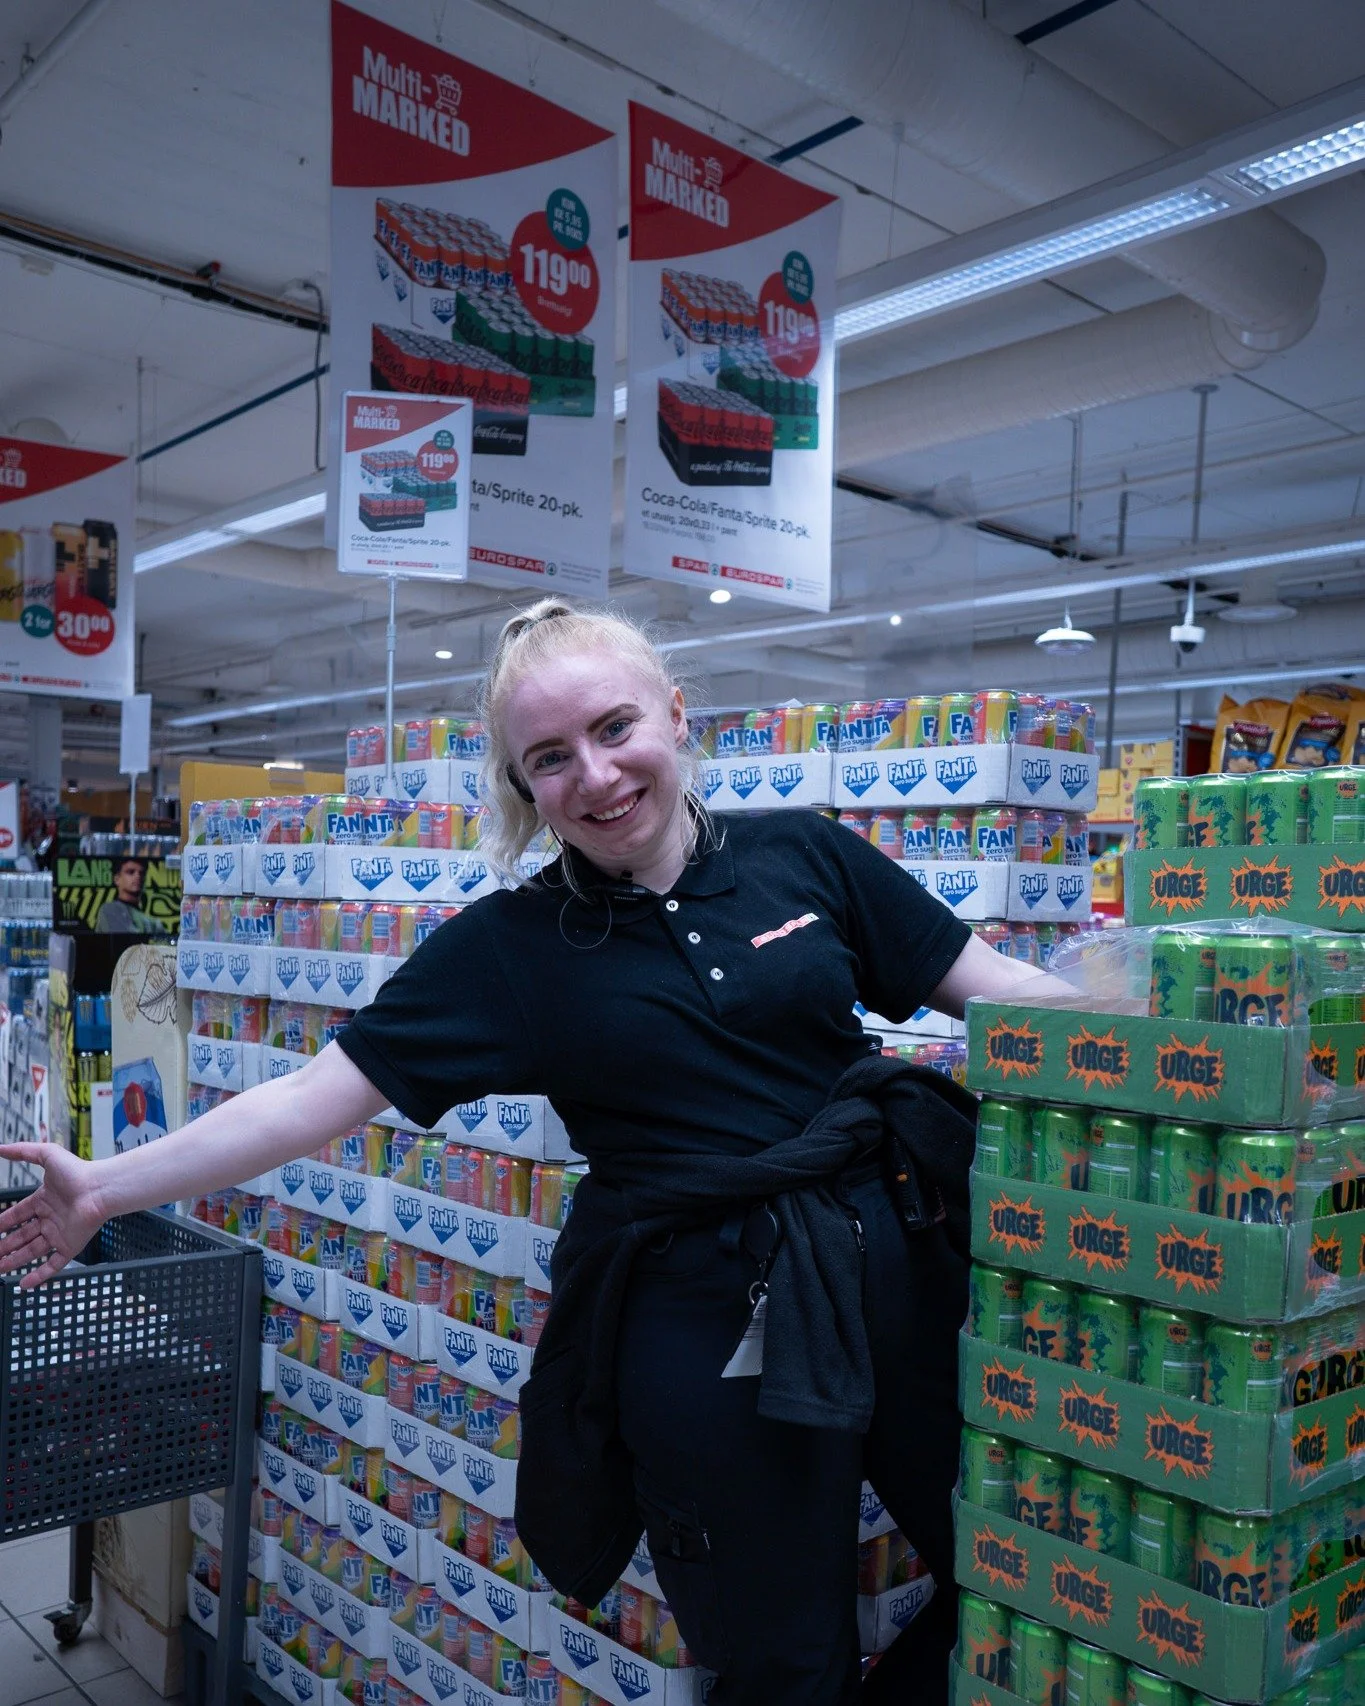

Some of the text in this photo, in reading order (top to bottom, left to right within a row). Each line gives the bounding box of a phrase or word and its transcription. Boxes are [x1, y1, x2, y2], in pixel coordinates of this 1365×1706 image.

[363, 46, 432, 101] Multi-
[352, 74, 470, 156] MARKED
[652, 137, 702, 182] Multi-
[645, 163, 729, 228] MARKED
[353, 416, 400, 431] MARKED
[539, 494, 583, 518] 20-pk.
[641, 487, 811, 539] Coca-Cola/Fanta/Sprite 20-pk.
[679, 558, 708, 573] SPAR
[726, 567, 784, 587] EUROSPAR
[25, 612, 34, 627] 2
[730, 766, 762, 784] FANTA
[769, 764, 803, 782] FANTA
[842, 762, 880, 782] FANTA
[887, 760, 927, 779] FANTA
[936, 756, 978, 778] FANTA
[1022, 760, 1051, 778] FANTA
[1060, 765, 1090, 783] FANTA
[1339, 784, 1357, 792] URGE
[262, 853, 286, 871] FANTA
[351, 858, 393, 875] FANTA
[402, 859, 441, 877] FANTA
[936, 871, 978, 890] FANTA
[1020, 874, 1048, 893] FANTA
[1057, 876, 1084, 894] FANTA
[1154, 871, 1204, 899] URGE
[1236, 870, 1290, 898] URGE
[276, 957, 300, 974] FANTA
[305, 960, 330, 977] FANTA
[336, 962, 364, 979] FANTA
[990, 1032, 1040, 1065] URGE
[1072, 1041, 1126, 1075] URGE
[1160, 1051, 1219, 1086] URGE
[498, 1102, 532, 1124] FANTA
[281, 1164, 304, 1182] FANTA
[310, 1172, 334, 1190] FANTA
[340, 1180, 366, 1200] FANTA
[394, 1196, 422, 1217] FANTA
[428, 1206, 459, 1229] FANTA
[466, 1218, 498, 1242] FANTA
[994, 1209, 1042, 1241] URGE
[1074, 1224, 1128, 1260] URGE
[1161, 1242, 1218, 1280] URGE
[291, 1268, 315, 1287] FANTA
[346, 1289, 373, 1312] FANTA
[380, 1303, 408, 1326] FANTA
[444, 1328, 478, 1353] FANTA
[486, 1344, 520, 1370] FANTA
[279, 1364, 303, 1386] FANTA
[307, 1378, 332, 1401] FANTA
[986, 1372, 1034, 1410] URGE
[338, 1392, 364, 1416] FANTA
[1064, 1397, 1116, 1437] URGE
[391, 1418, 420, 1443] FANTA
[426, 1436, 457, 1463] FANTA
[1151, 1423, 1209, 1466] URGE
[463, 1454, 496, 1483] FANTA
[347, 1500, 373, 1525] FANTA
[380, 1519, 408, 1546] FANTA
[443, 1556, 476, 1585] FANTA
[978, 1539, 1024, 1580] URGE
[484, 1580, 518, 1613] FANTA
[890, 1586, 923, 1618] FANTA
[1056, 1573, 1108, 1616] URGE
[339, 1598, 365, 1626] FANTA
[1142, 1607, 1201, 1652] URGE
[393, 1636, 422, 1664] FANTA
[560, 1625, 599, 1660] FANTA
[427, 1659, 458, 1690] FANTA
[610, 1653, 650, 1690] FANTA
